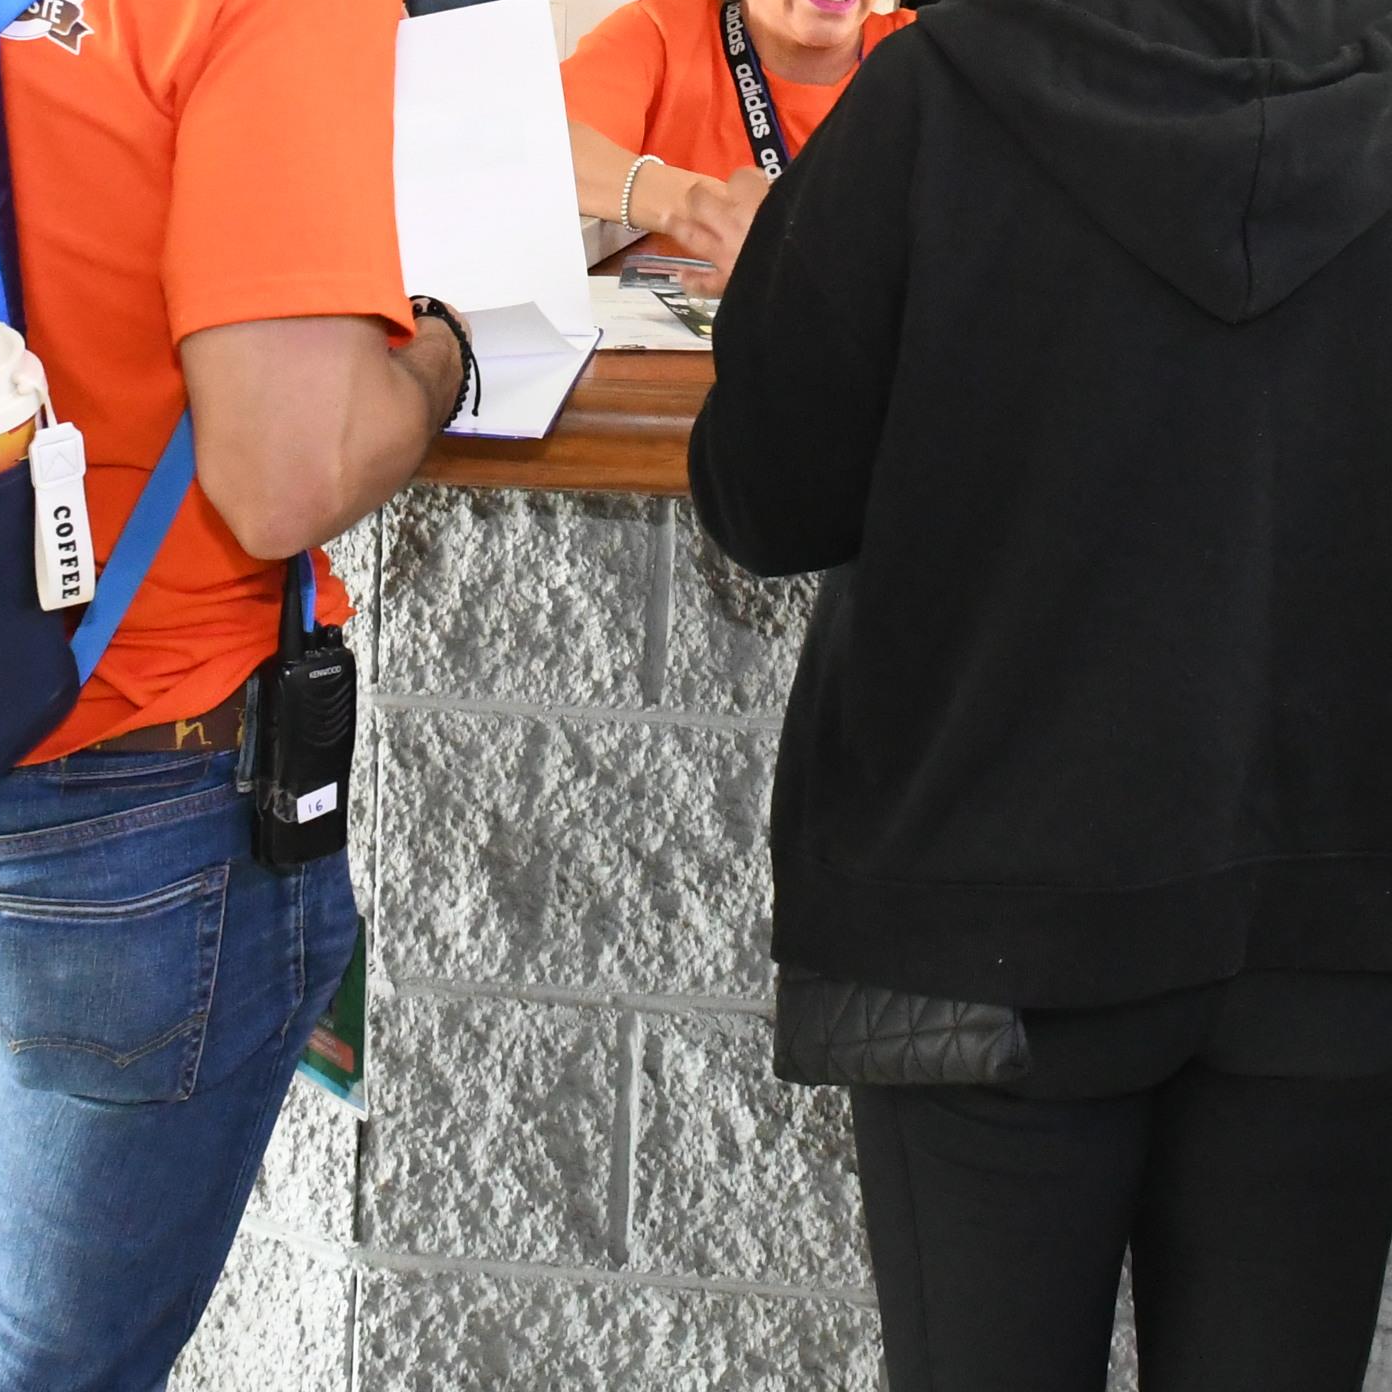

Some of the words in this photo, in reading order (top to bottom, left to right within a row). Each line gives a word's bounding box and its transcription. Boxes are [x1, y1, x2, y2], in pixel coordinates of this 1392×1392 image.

[735, 63, 771, 139] adidas
[53, 505, 80, 600] COFFEE
[309, 665, 342, 679] KENWOOD
[308, 799, 323, 814] 16
